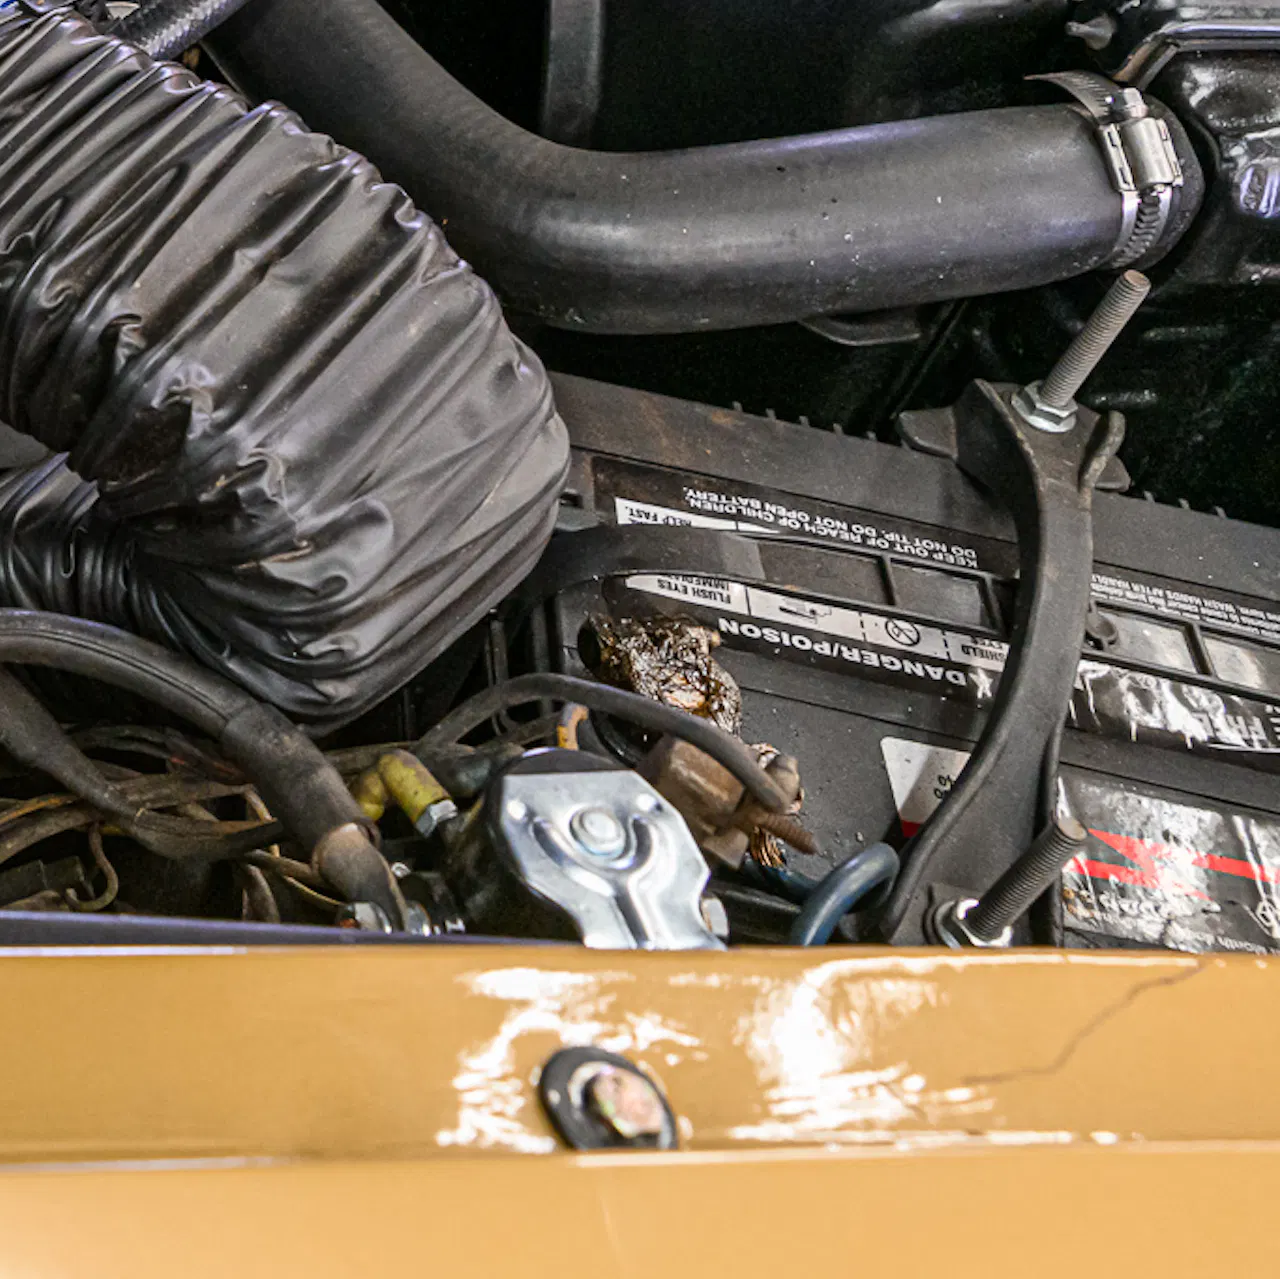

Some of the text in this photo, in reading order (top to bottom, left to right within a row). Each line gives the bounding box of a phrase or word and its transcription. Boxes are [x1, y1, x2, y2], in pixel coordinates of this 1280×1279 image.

[682, 486, 977, 559] DO NOT TIP. DO NOT OPEN BATTERY.
[684, 495, 978, 569] KEEP OUT OF REACH OF CHILDREN.
[657, 578, 732, 605] FLUSH EYES
[717, 617, 968, 687] DANGER/POISON
